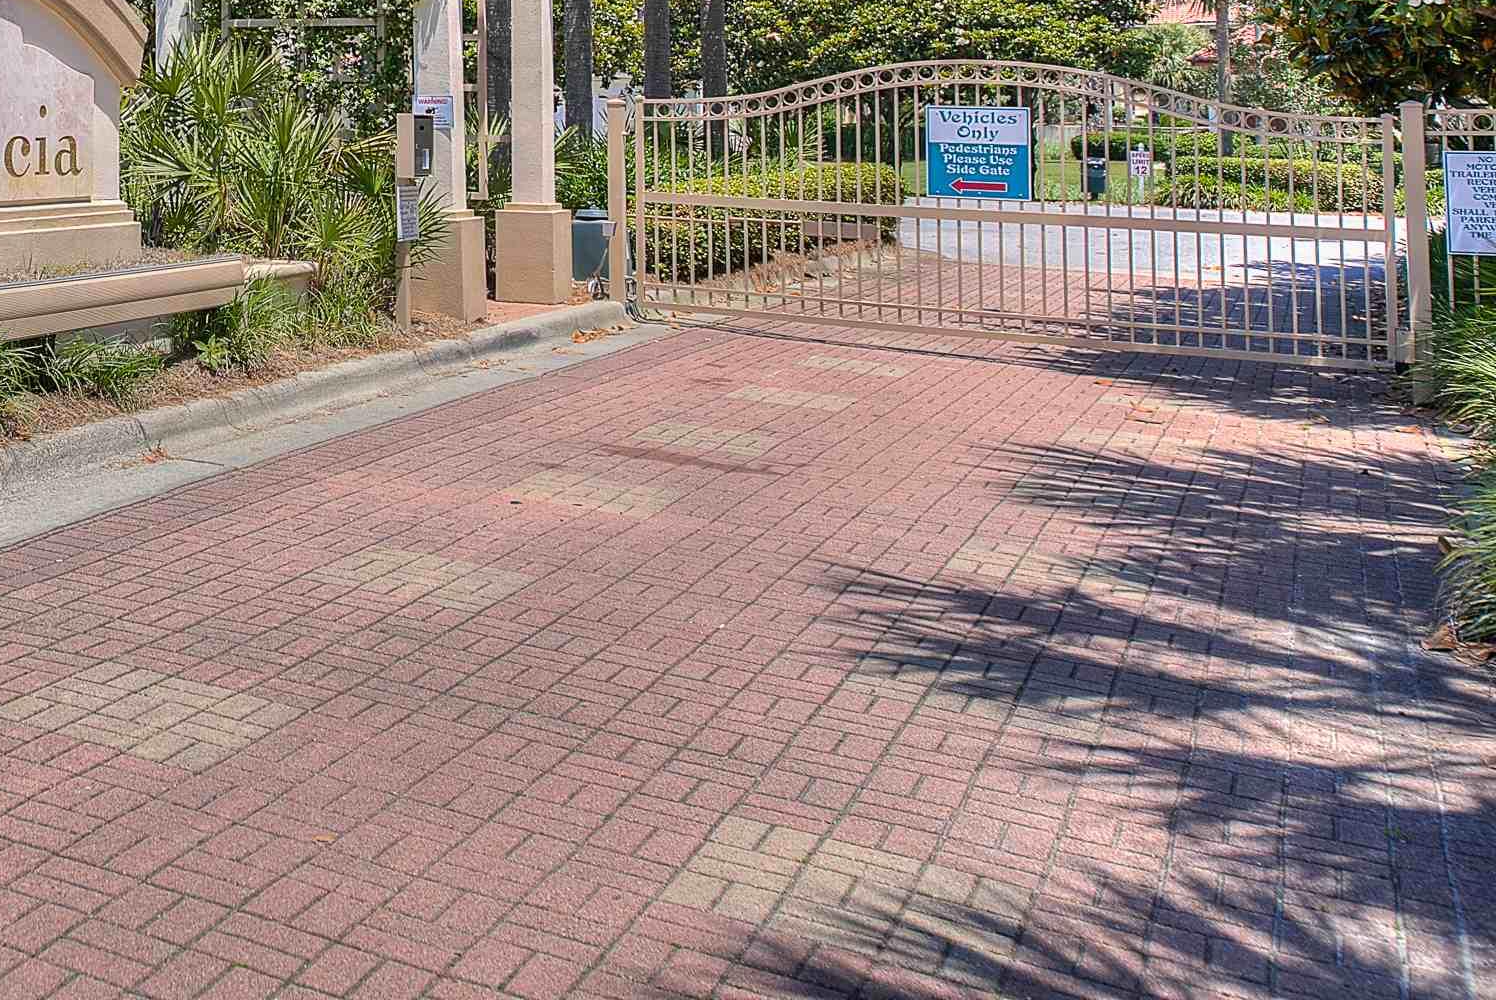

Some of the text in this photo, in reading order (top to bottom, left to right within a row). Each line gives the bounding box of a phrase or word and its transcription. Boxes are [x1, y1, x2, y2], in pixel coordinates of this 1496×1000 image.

[938, 110, 1018, 125] Vehicles
[957, 125, 1000, 142] Only
[939, 143, 1018, 157] Pedestrians
[943, 154, 1014, 166] Please Use
[946, 164, 1011, 176] Side Gate
[1135, 165, 1148, 175] 12
[1452, 207, 1489, 216] SHALL
